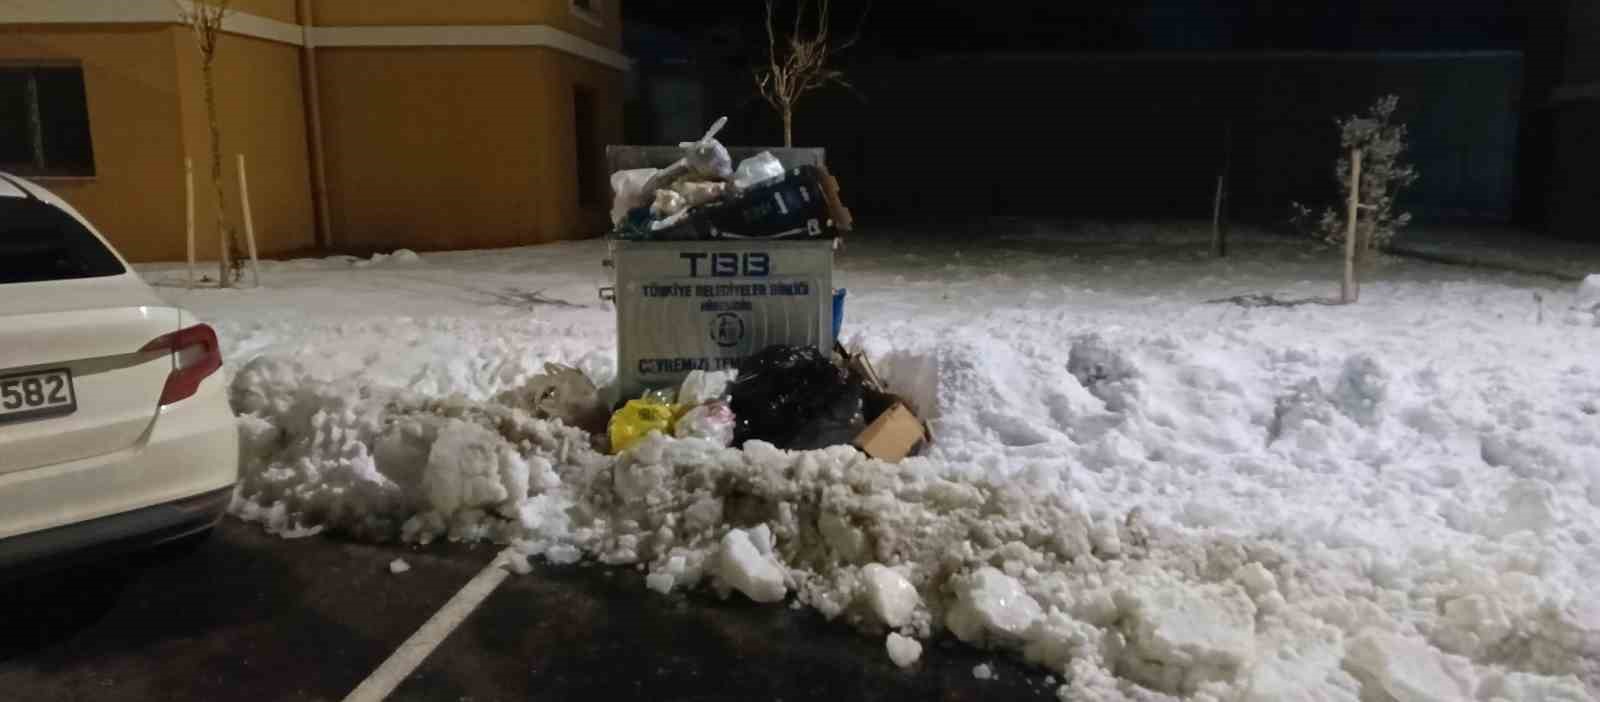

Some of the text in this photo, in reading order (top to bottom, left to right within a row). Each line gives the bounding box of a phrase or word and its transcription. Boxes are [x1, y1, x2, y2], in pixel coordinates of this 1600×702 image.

[680, 252, 770, 277] TBB
[642, 281, 692, 297] TÜRKİYE
[1, 375, 67, 409] 582
